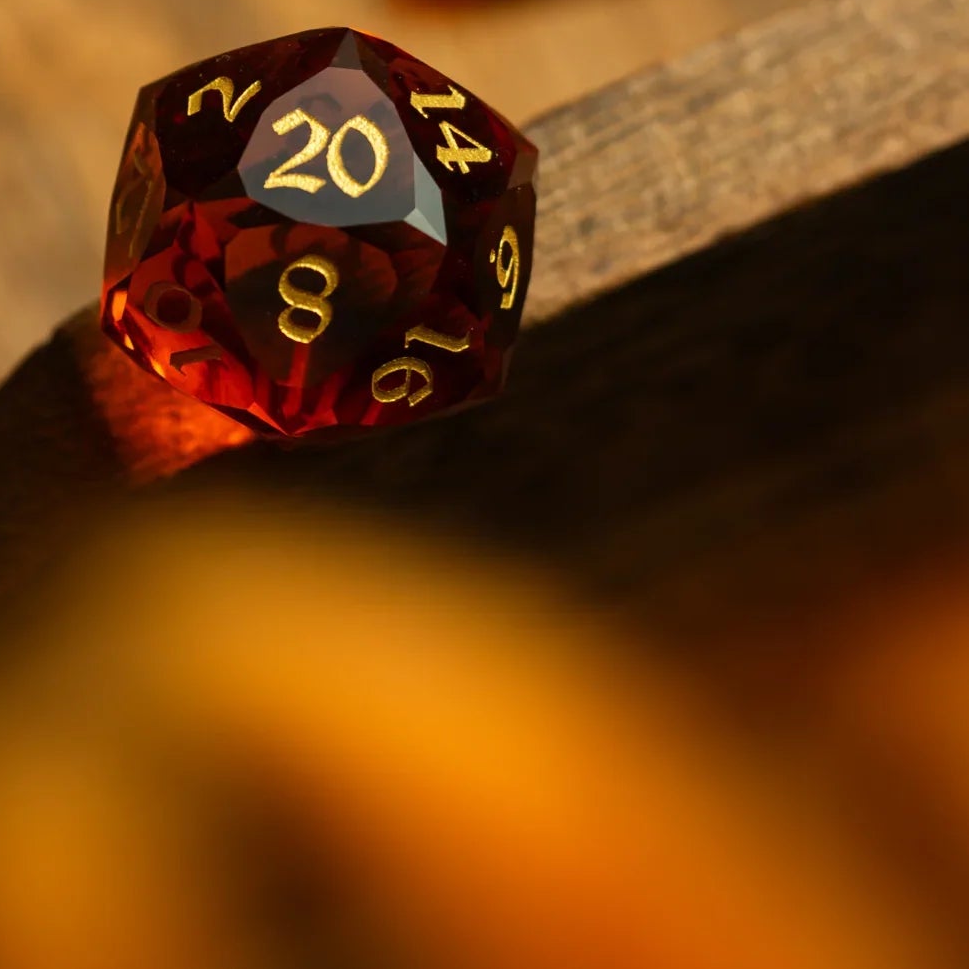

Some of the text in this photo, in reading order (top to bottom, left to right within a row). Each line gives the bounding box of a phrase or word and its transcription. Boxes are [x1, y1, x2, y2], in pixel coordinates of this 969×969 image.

[187, 77, 261, 122] 2
[410, 84, 492, 174] 14
[263, 108, 389, 198] 20
[278, 254, 339, 344] 8
[372, 325, 470, 407] 16
